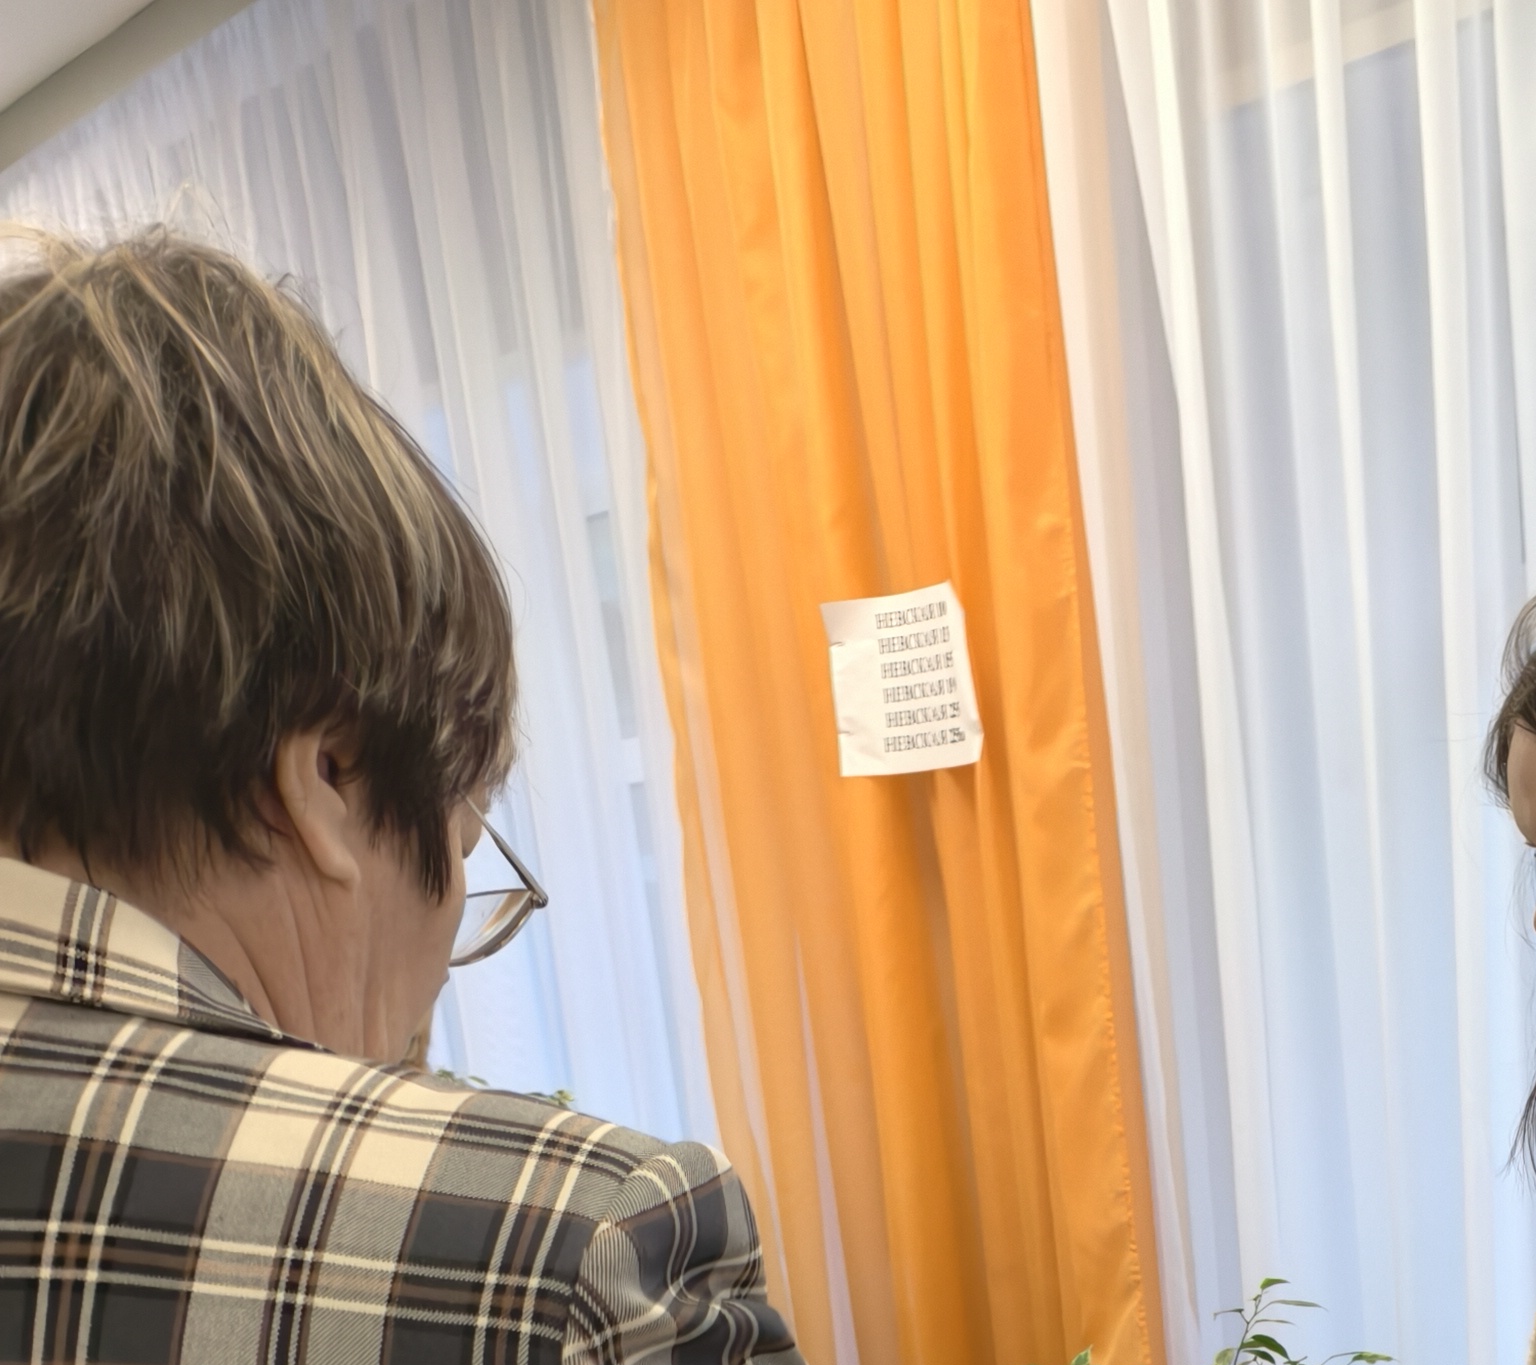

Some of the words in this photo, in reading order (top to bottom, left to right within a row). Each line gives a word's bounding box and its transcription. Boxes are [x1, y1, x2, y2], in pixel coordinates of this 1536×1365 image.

[875, 603, 936, 629] НЕВСКАЯ
[877, 629, 939, 654] НЕВСКАЯ
[880, 654, 943, 679] НЕВСКАЯ
[883, 679, 945, 704] НЕВСКАЯ
[885, 703, 948, 728] НЕВСКАЯ
[883, 729, 948, 753] НЕВСКАЯ
